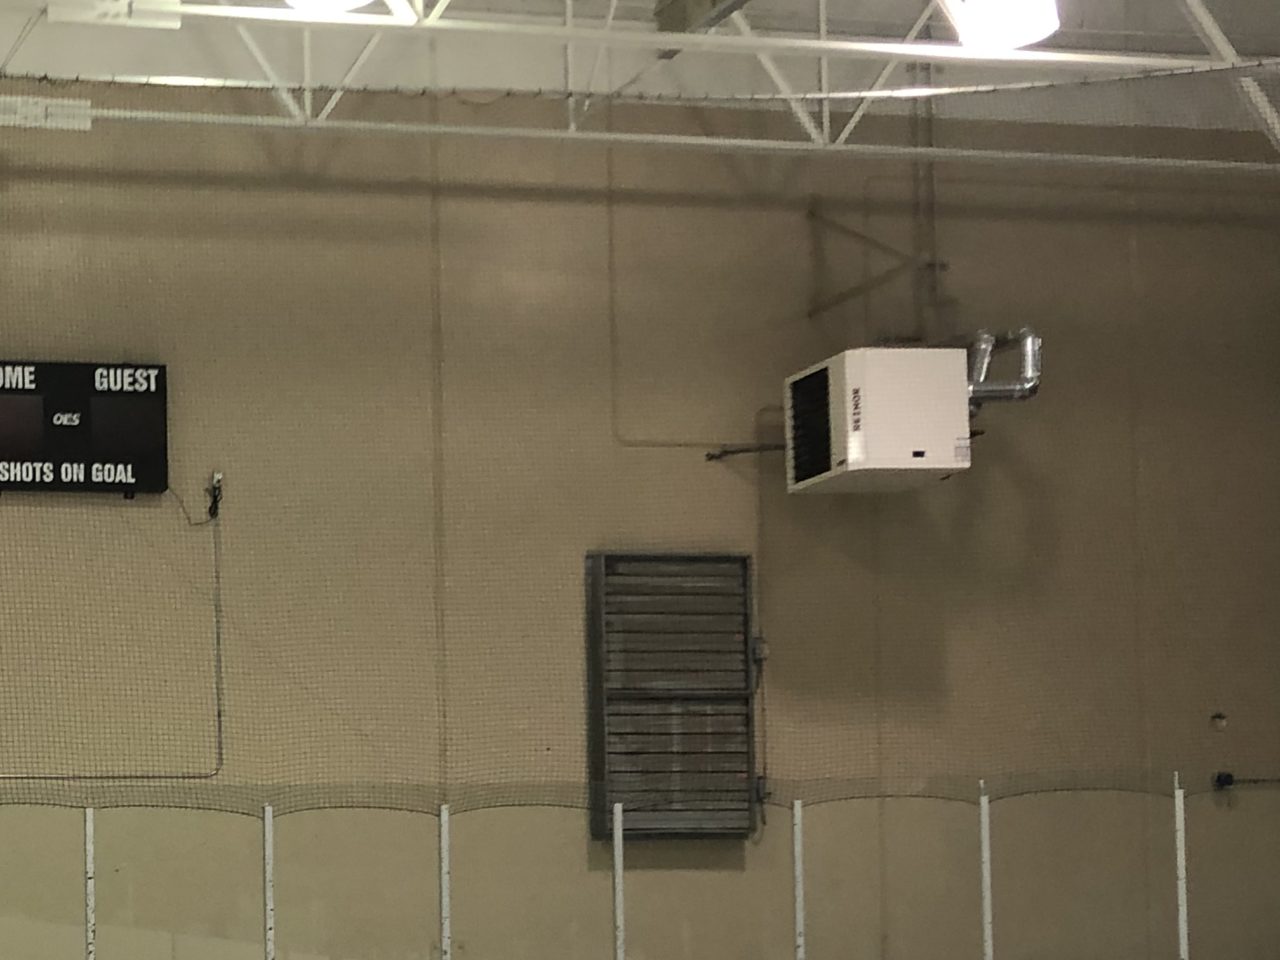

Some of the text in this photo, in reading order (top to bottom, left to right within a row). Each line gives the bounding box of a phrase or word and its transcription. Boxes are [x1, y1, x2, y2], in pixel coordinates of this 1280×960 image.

[94, 368, 158, 392] GUEST
[60, 463, 85, 482] ON
[91, 463, 136, 483] GOAL
